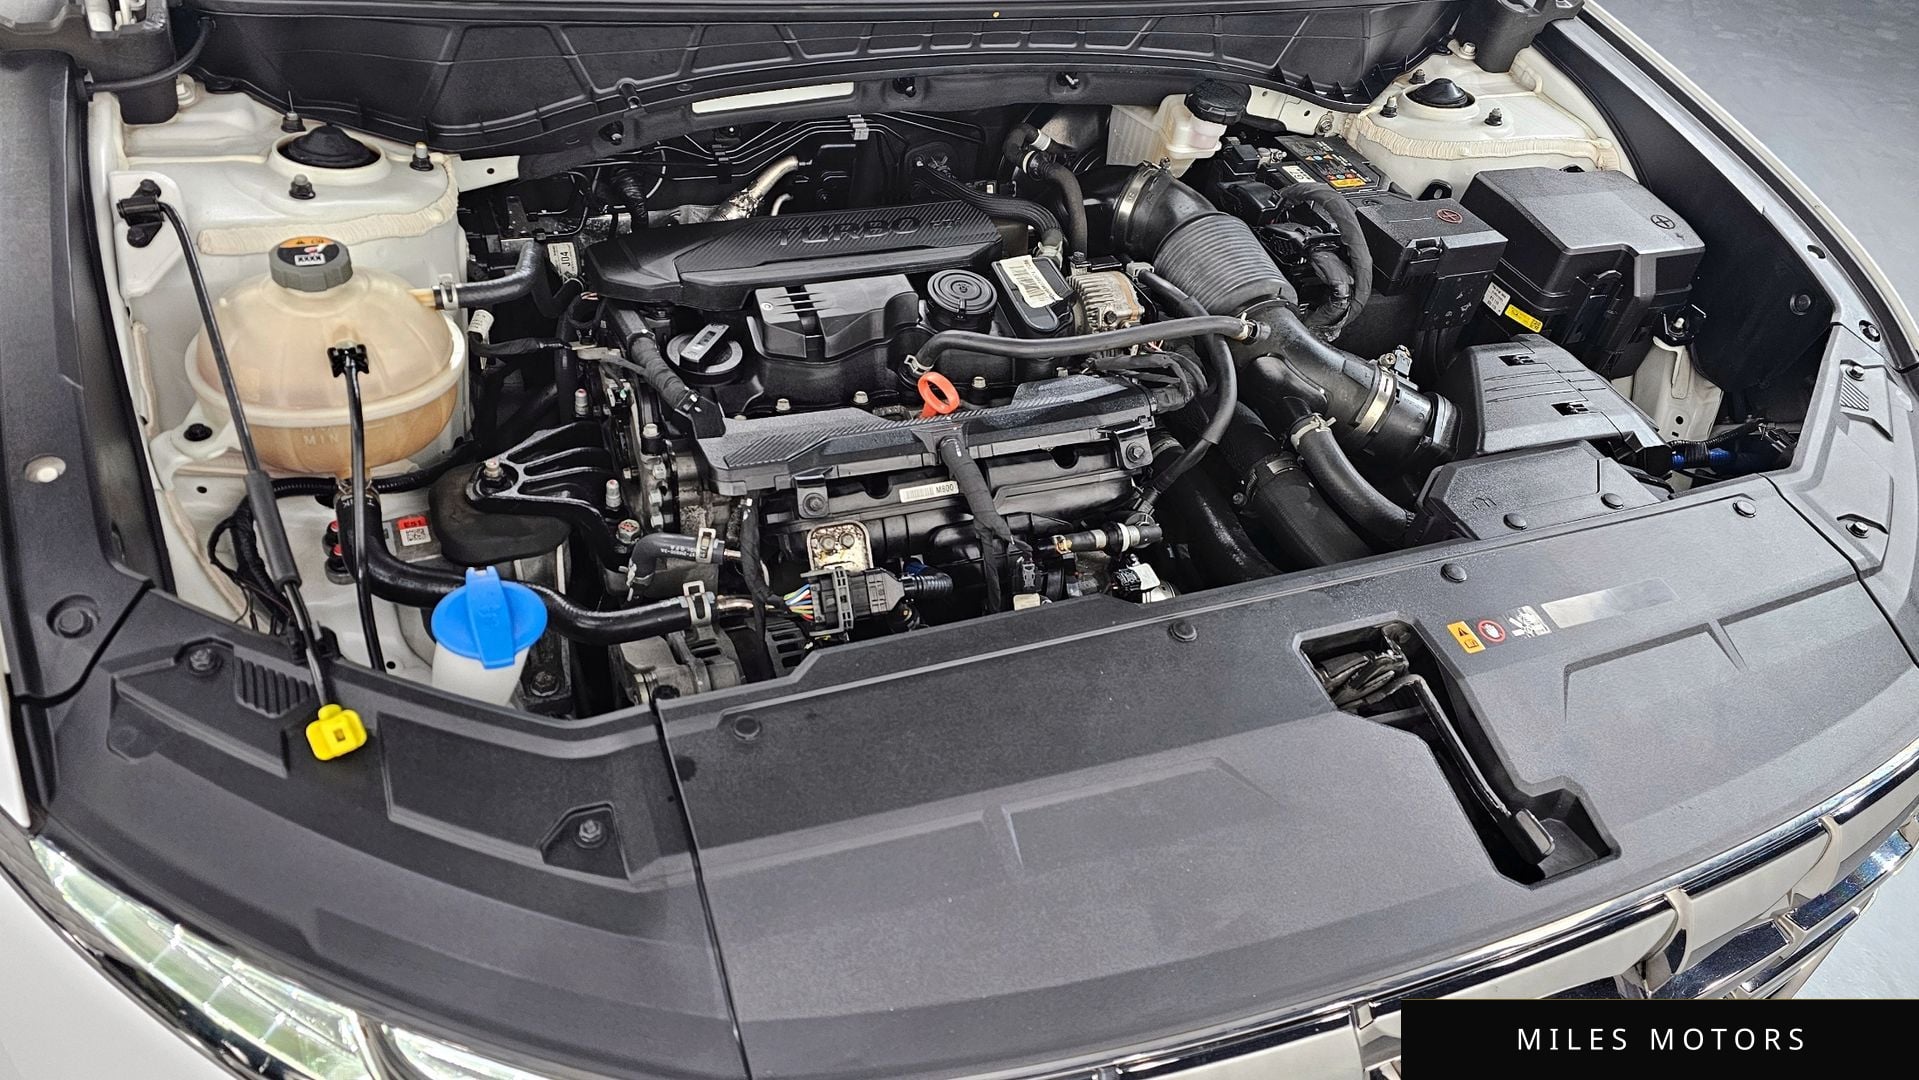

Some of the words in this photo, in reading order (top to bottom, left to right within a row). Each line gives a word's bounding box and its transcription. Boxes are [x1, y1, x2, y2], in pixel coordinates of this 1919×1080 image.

[770, 217, 920, 246] TURBO
[560, 251, 571, 267] J04
[303, 433, 339, 445] MIN
